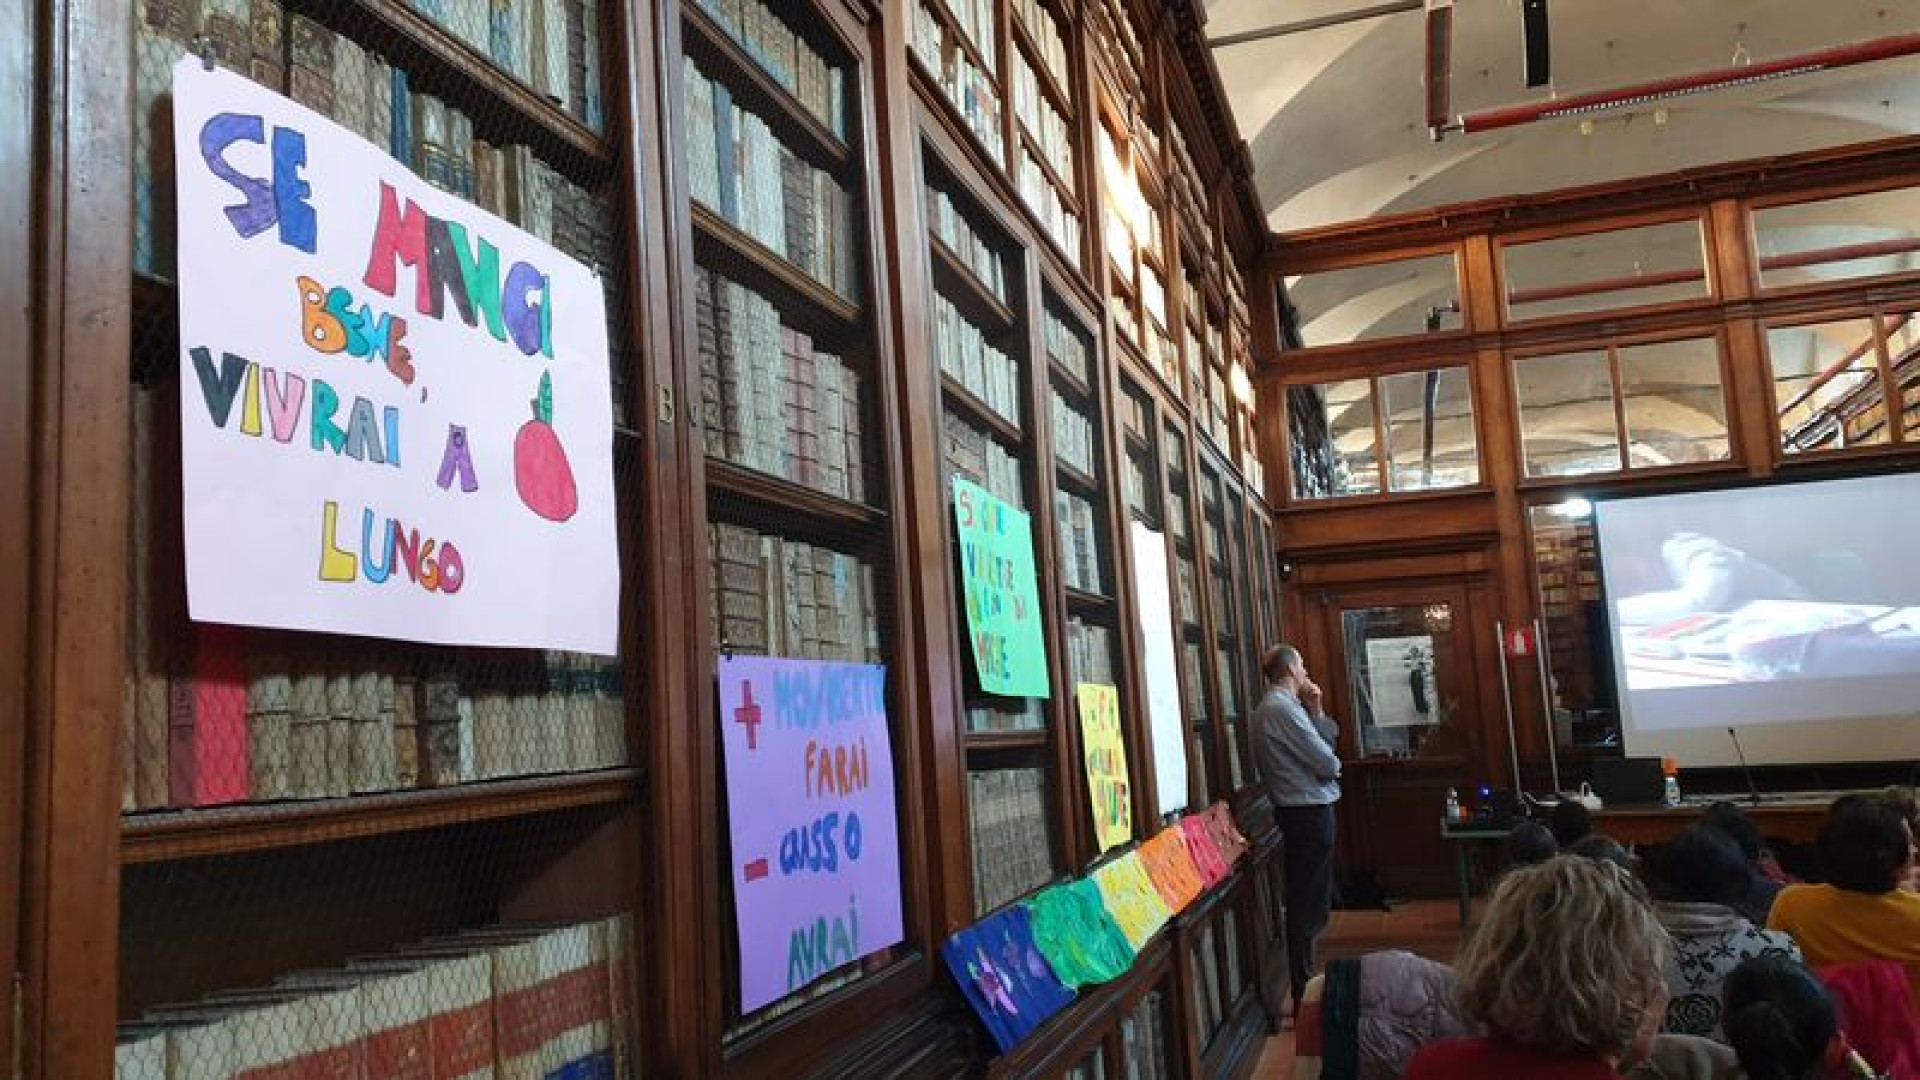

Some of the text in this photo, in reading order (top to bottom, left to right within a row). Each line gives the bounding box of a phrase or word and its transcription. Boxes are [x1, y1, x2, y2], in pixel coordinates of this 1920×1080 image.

[200, 112, 554, 359] SE MANGI
[189, 345, 479, 493] VIVRAI A
[318, 500, 465, 594] LUNGO
